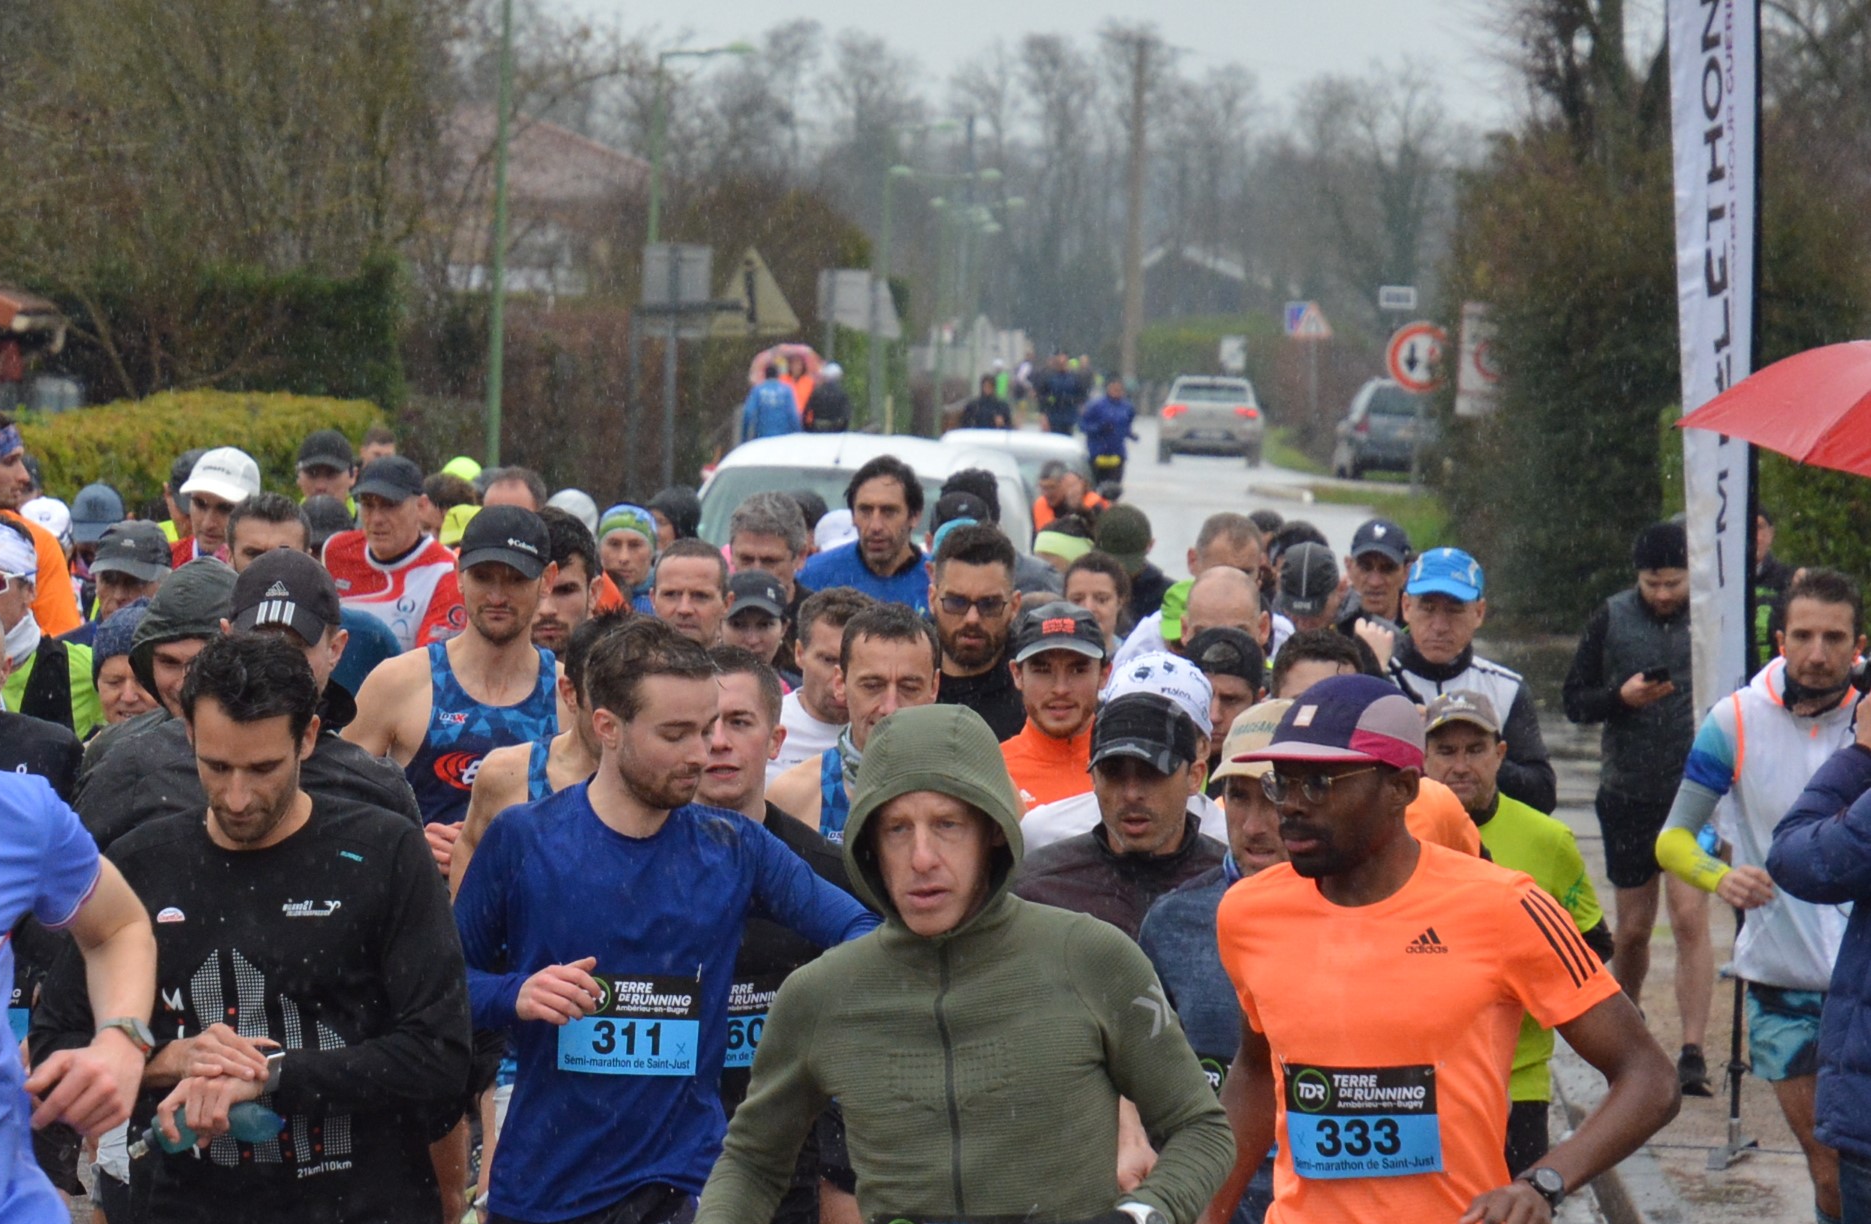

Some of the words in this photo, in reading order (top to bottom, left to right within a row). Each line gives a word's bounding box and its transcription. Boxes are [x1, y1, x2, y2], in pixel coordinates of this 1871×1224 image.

[1405, 945, 1448, 954] adidas
[614, 981, 654, 994] TERRE
[618, 993, 631, 1002] DE
[631, 994, 692, 1007] RUNNING
[592, 1020, 662, 1056] 311
[564, 1054, 632, 1069] Semi-marathon
[634, 1057, 645, 1068] de
[647, 1058, 690, 1070] Saint-Just
[1332, 1074, 1378, 1088] TERRE
[1298, 1082, 1326, 1100] TDR
[1339, 1088, 1353, 1098] DE
[1353, 1086, 1426, 1101] RUNNING
[1315, 1118, 1402, 1157] 333
[1366, 1159, 1379, 1170] de
[1382, 1156, 1435, 1170] Saint-Just
